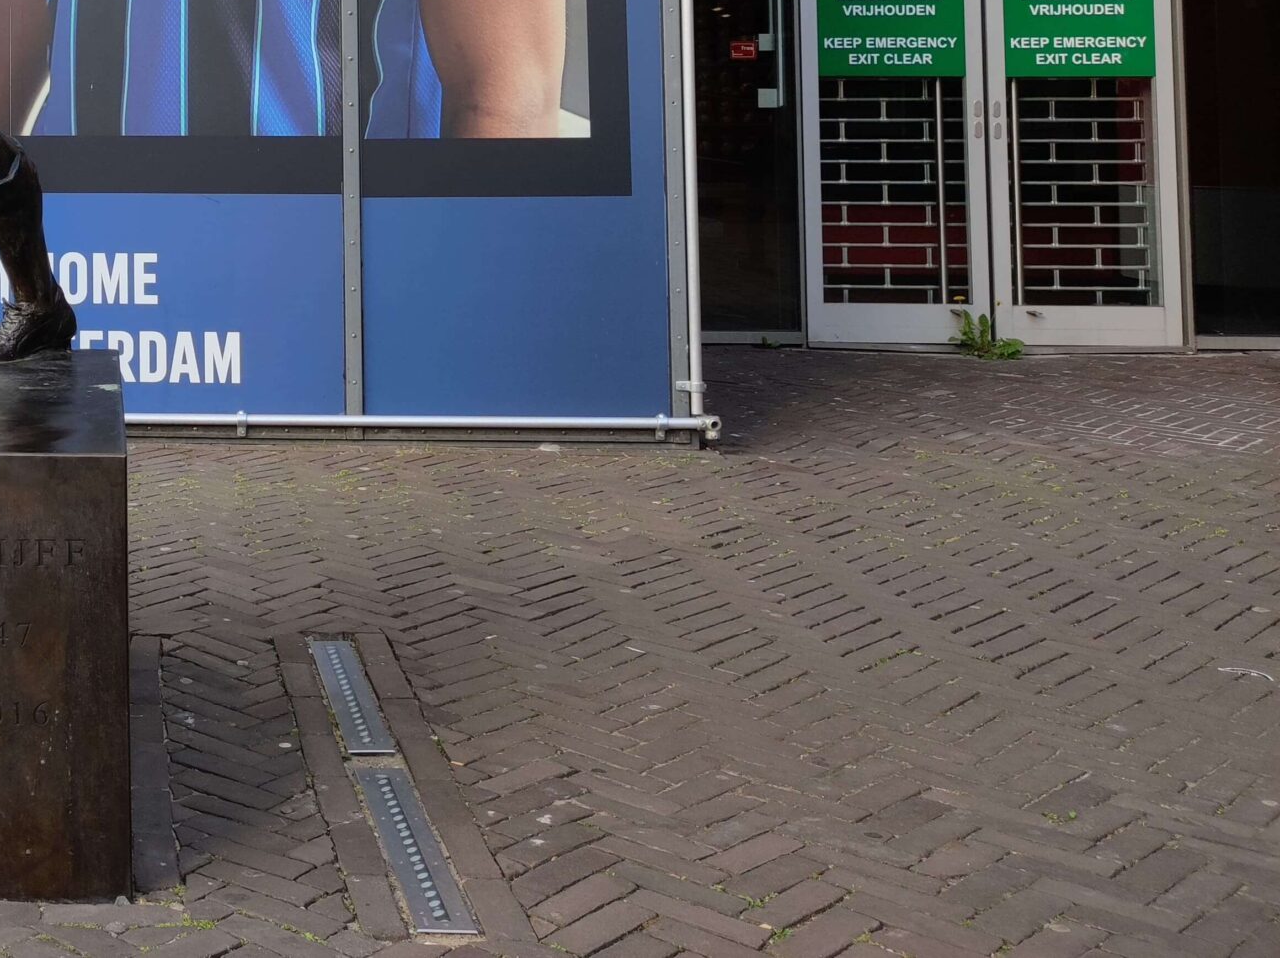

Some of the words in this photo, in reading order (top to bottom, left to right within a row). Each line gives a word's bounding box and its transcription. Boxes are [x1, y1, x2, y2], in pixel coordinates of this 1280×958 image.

[842, 4, 936, 16] VRIJHOUDEN
[1029, 3, 1125, 15] VRIJHOUDEN
[824, 37, 862, 48] KEEP
[866, 37, 957, 48] EMERGENCY
[1010, 37, 1049, 48] KEEP
[1053, 36, 1147, 48] EMERGENCY
[848, 53, 880, 65] EXIT
[884, 53, 933, 65] CLEAR
[1036, 53, 1068, 65] EXIT
[1072, 53, 1122, 65] CLEAR
[51, 251, 159, 305] OME
